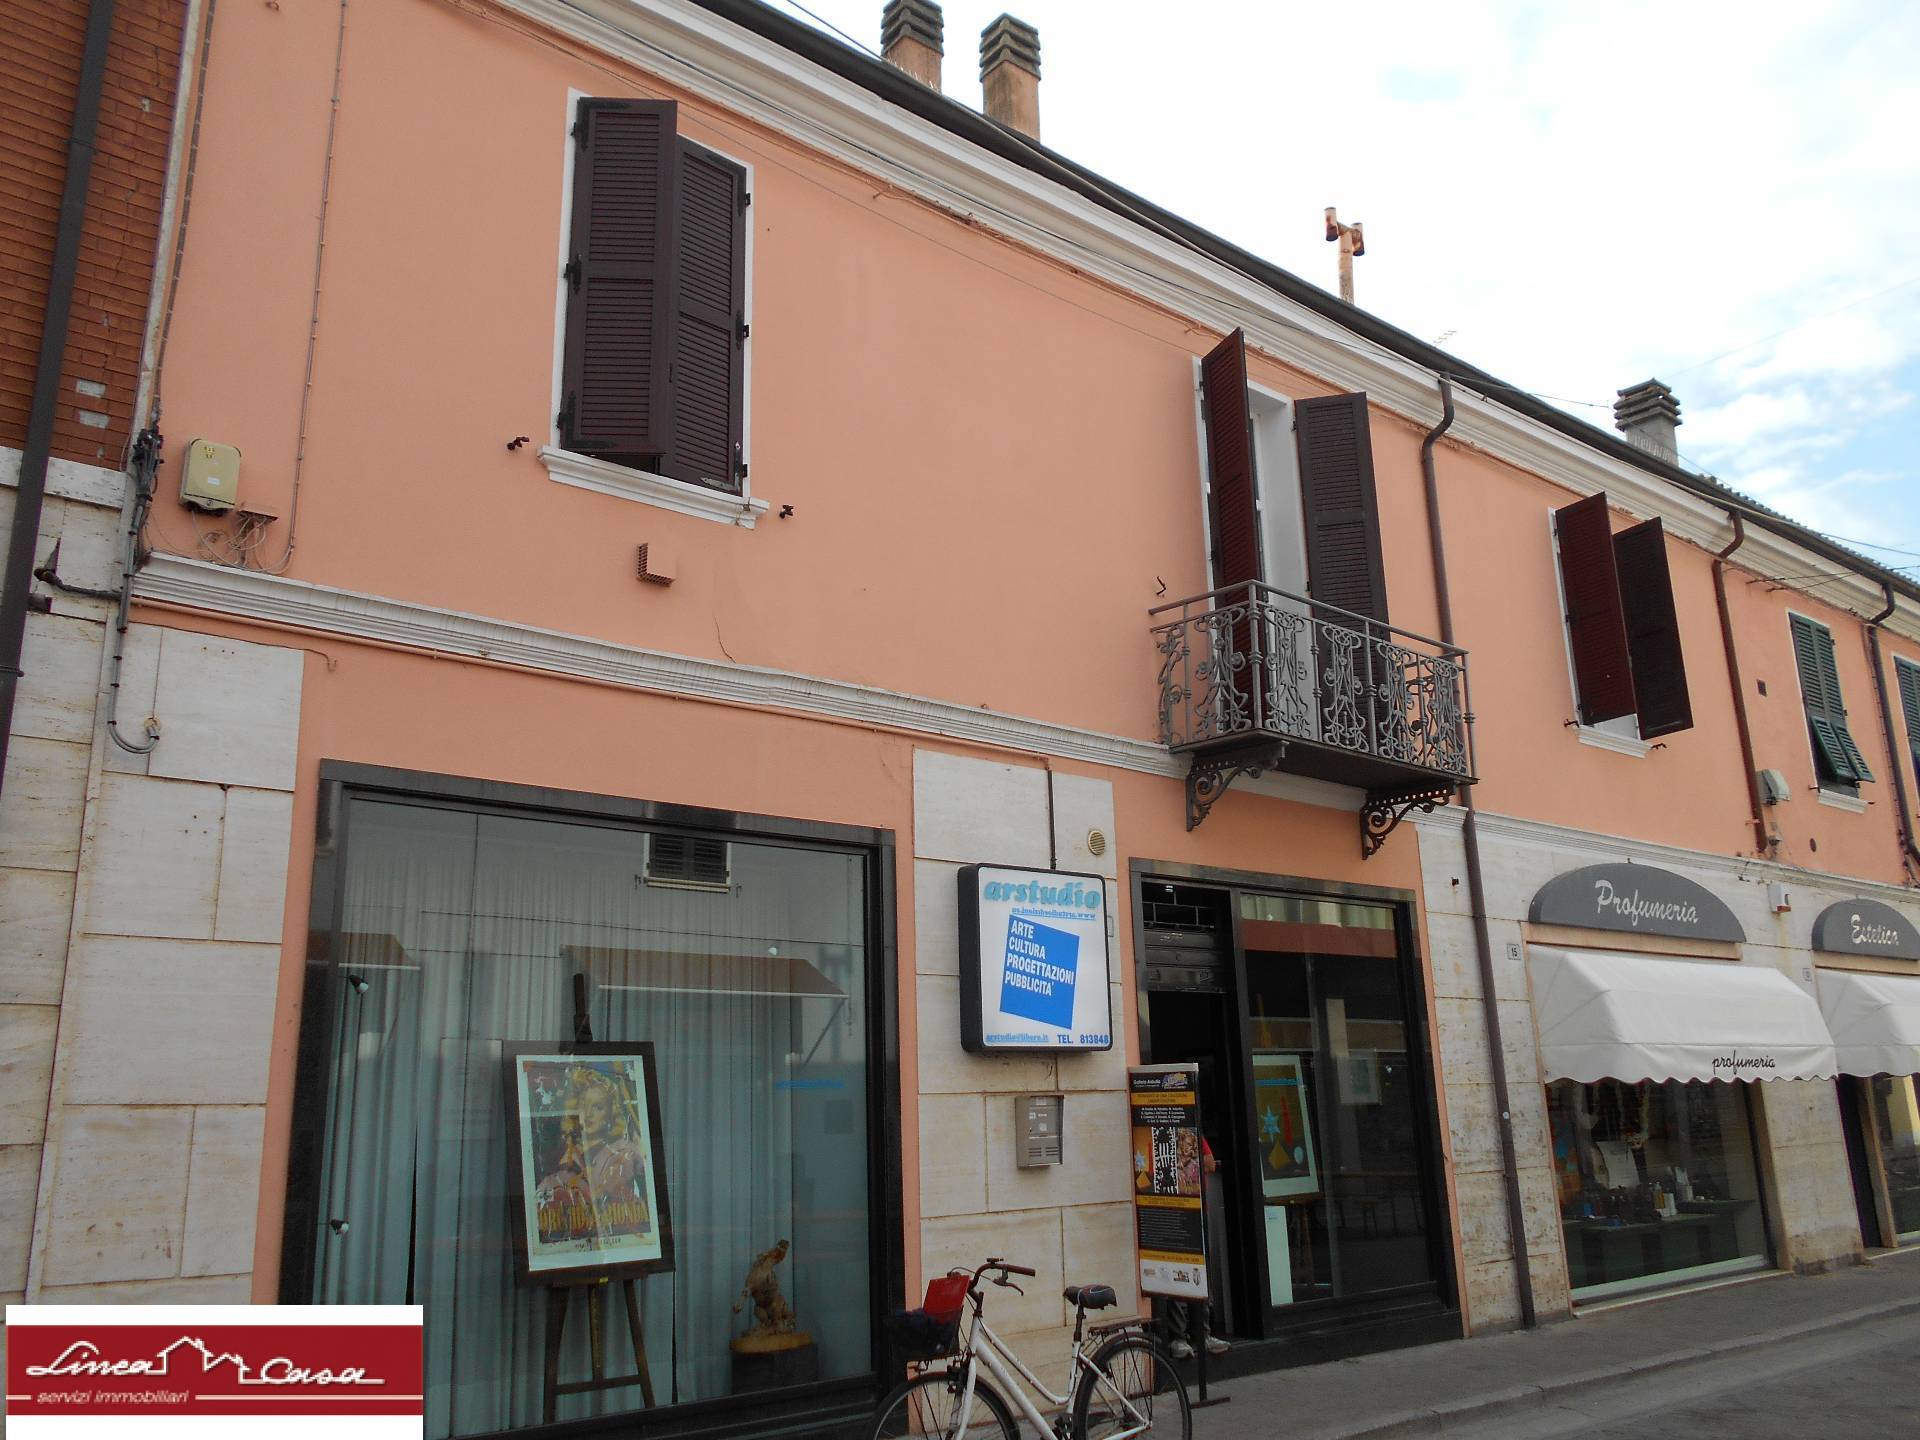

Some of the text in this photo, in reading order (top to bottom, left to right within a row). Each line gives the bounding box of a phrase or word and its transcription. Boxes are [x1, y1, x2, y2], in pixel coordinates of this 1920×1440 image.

[984, 880, 1101, 909] arstudio
[1594, 879, 1700, 927] Profumeria
[1011, 919, 1035, 939] ARTE
[1850, 914, 1900, 946] Estetica
[1008, 936, 1046, 960] CULTURA
[1006, 953, 1075, 985] PROGETTAZIONI
[1057, 1034, 1109, 1044] TEL. 813848
[1712, 1050, 1776, 1075] profumeria
